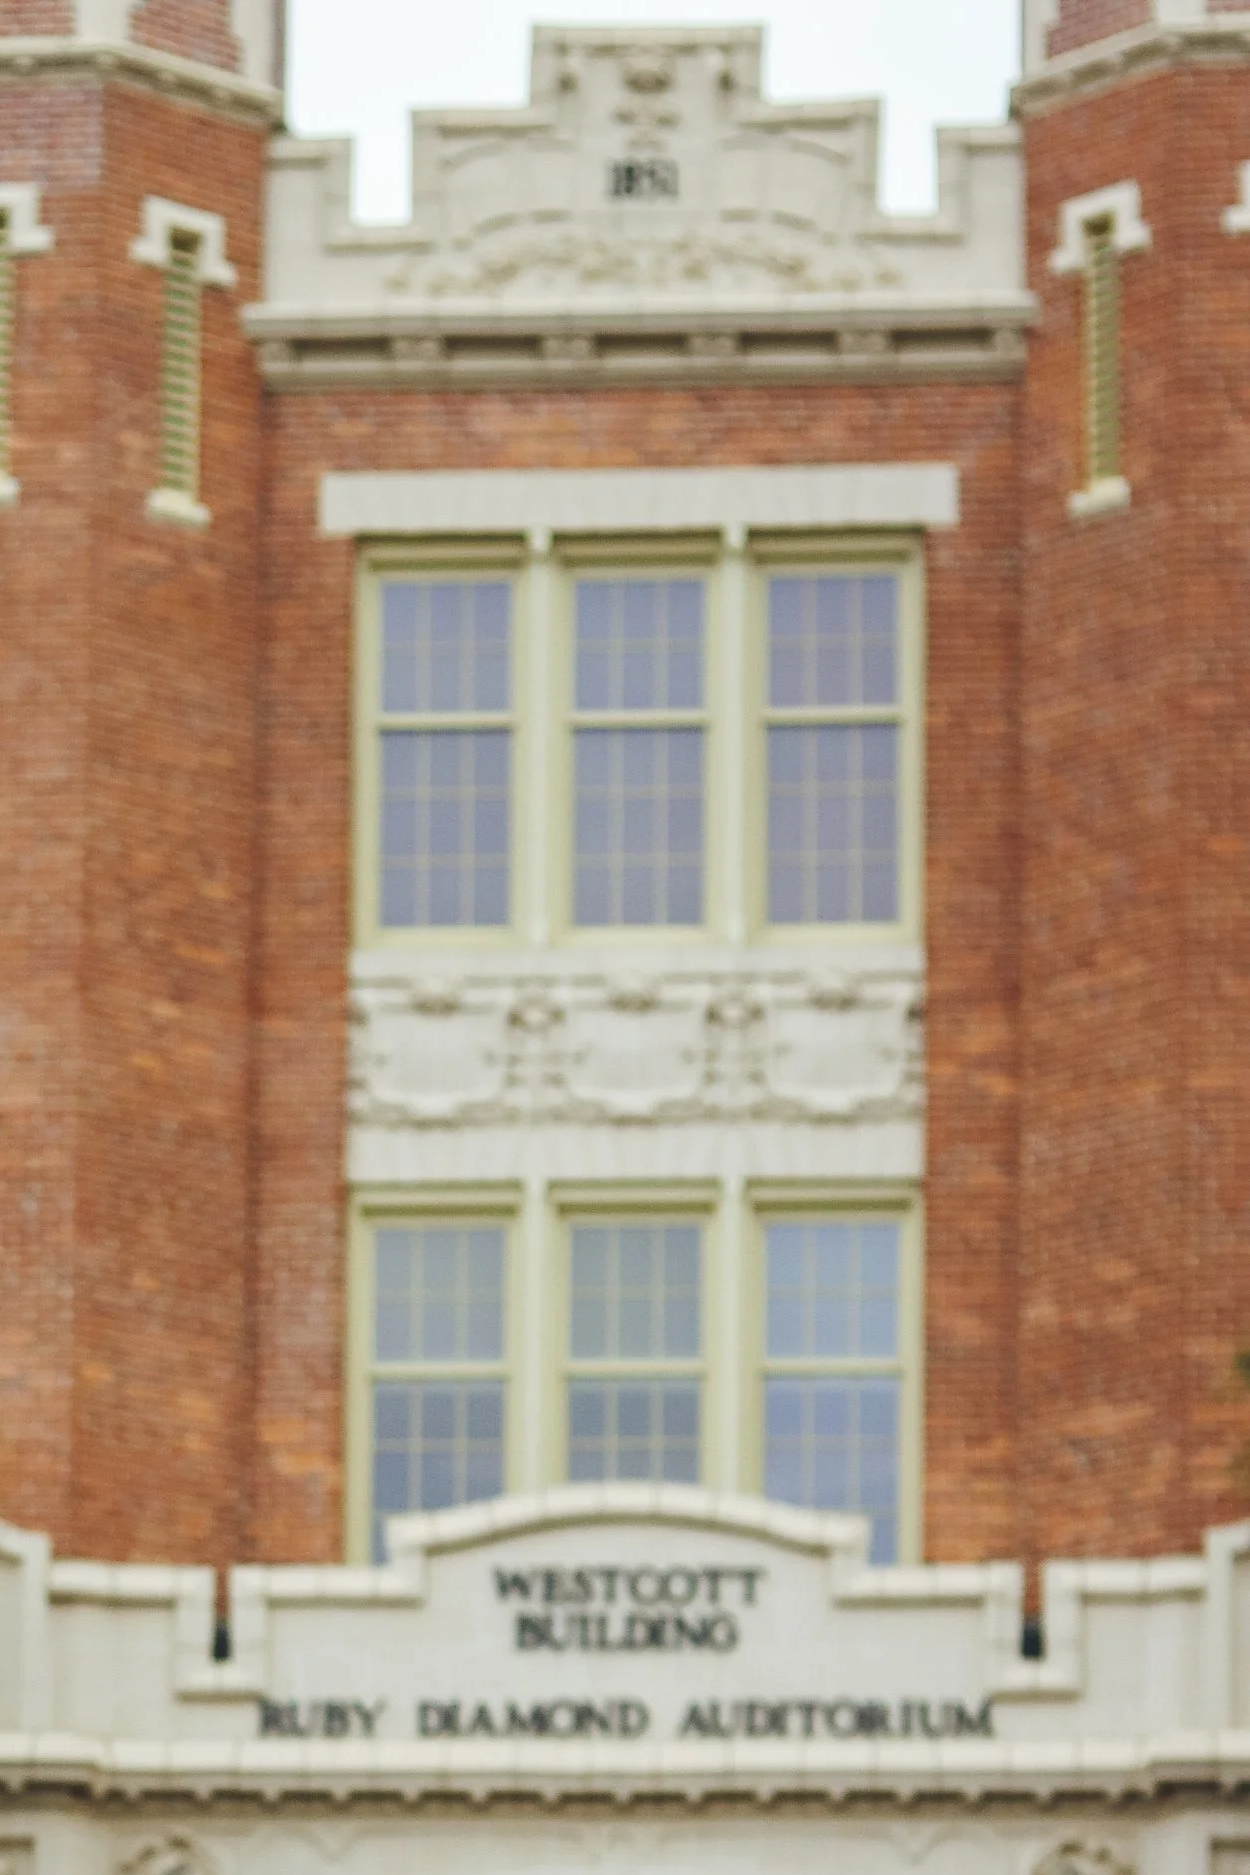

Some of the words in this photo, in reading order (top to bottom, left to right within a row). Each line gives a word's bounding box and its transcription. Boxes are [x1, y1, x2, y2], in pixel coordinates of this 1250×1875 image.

[492, 1566, 766, 1606] WESTCOTT
[514, 1611, 740, 1652] BUILDING
[258, 1697, 387, 1739] RUBY
[417, 1696, 652, 1740] DIAMOND
[678, 1696, 996, 1739] AUDITORIUM
